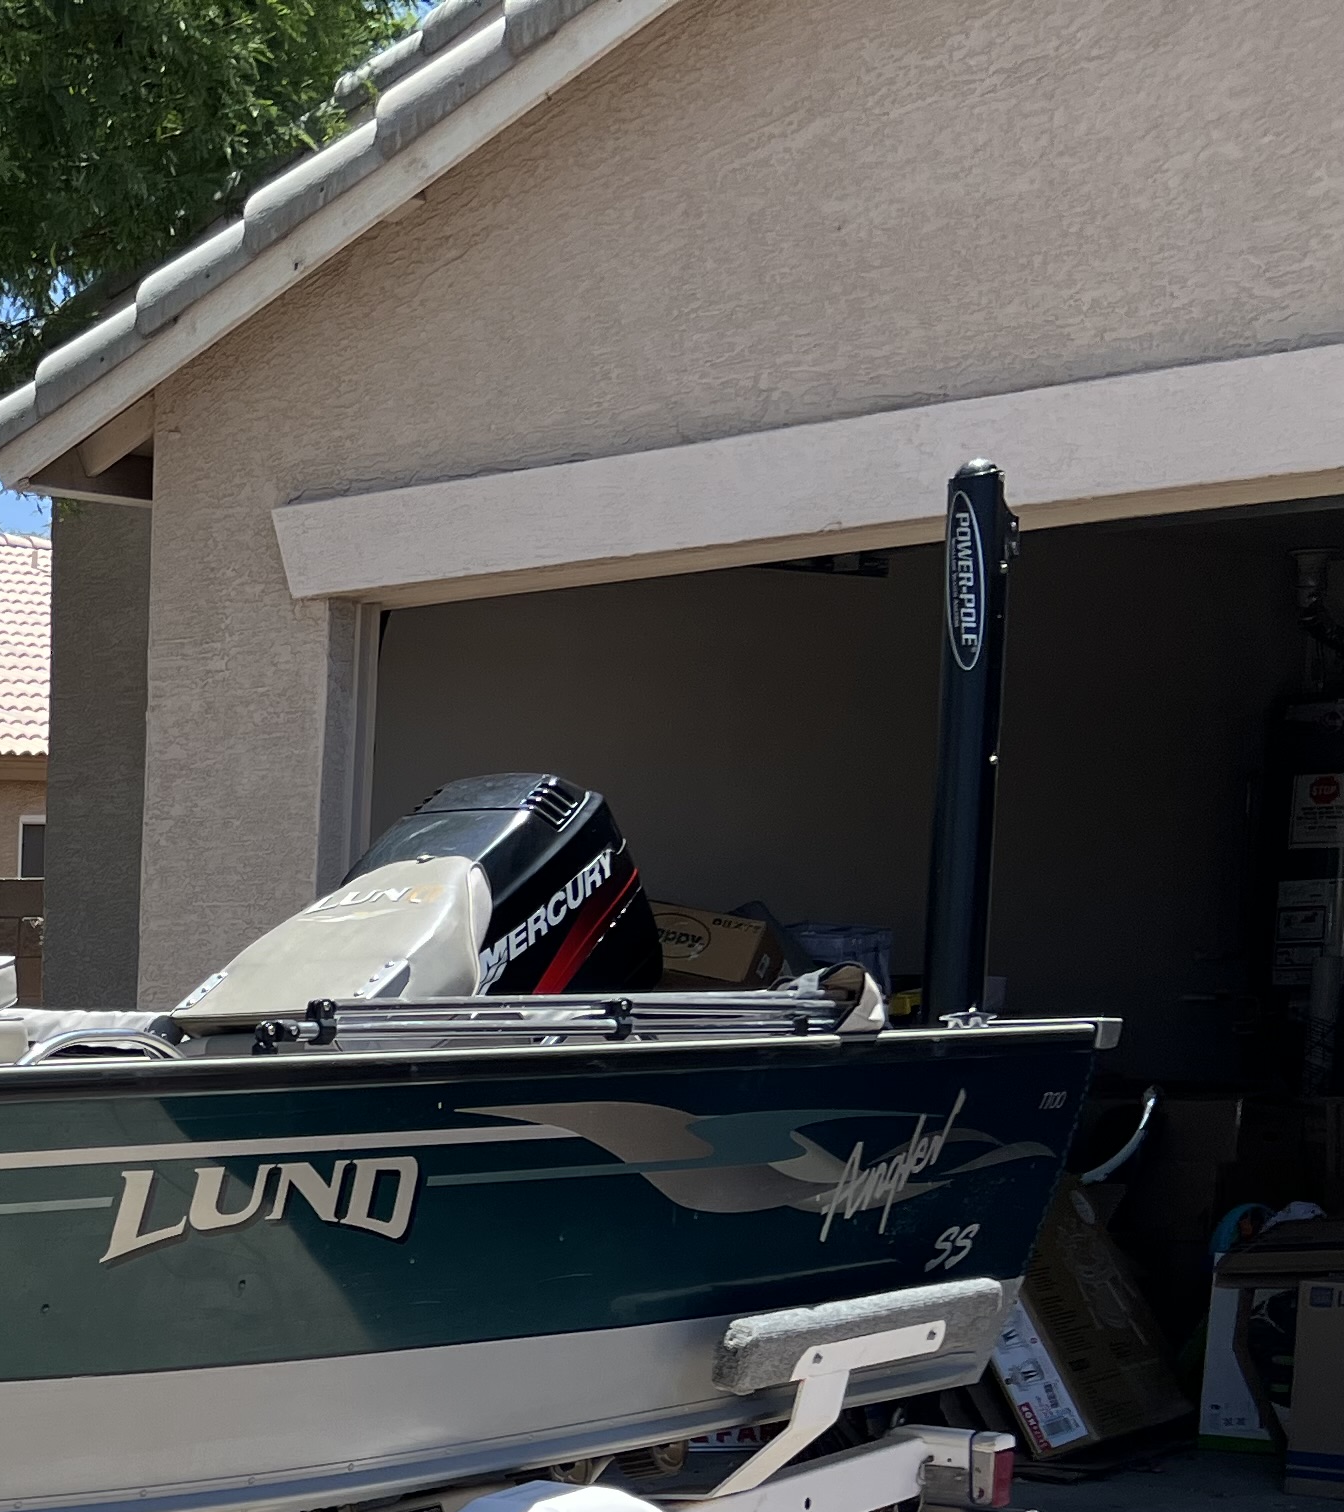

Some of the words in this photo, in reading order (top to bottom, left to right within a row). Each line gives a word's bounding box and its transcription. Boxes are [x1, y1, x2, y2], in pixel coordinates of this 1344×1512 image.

[955, 511, 978, 647] POWER-POLE
[1311, 783, 1337, 797] STOP
[478, 849, 614, 983] MERCURY
[99, 1155, 419, 1264] LUND
[816, 1087, 967, 1243] Angler
[924, 1222, 981, 1273] SS
